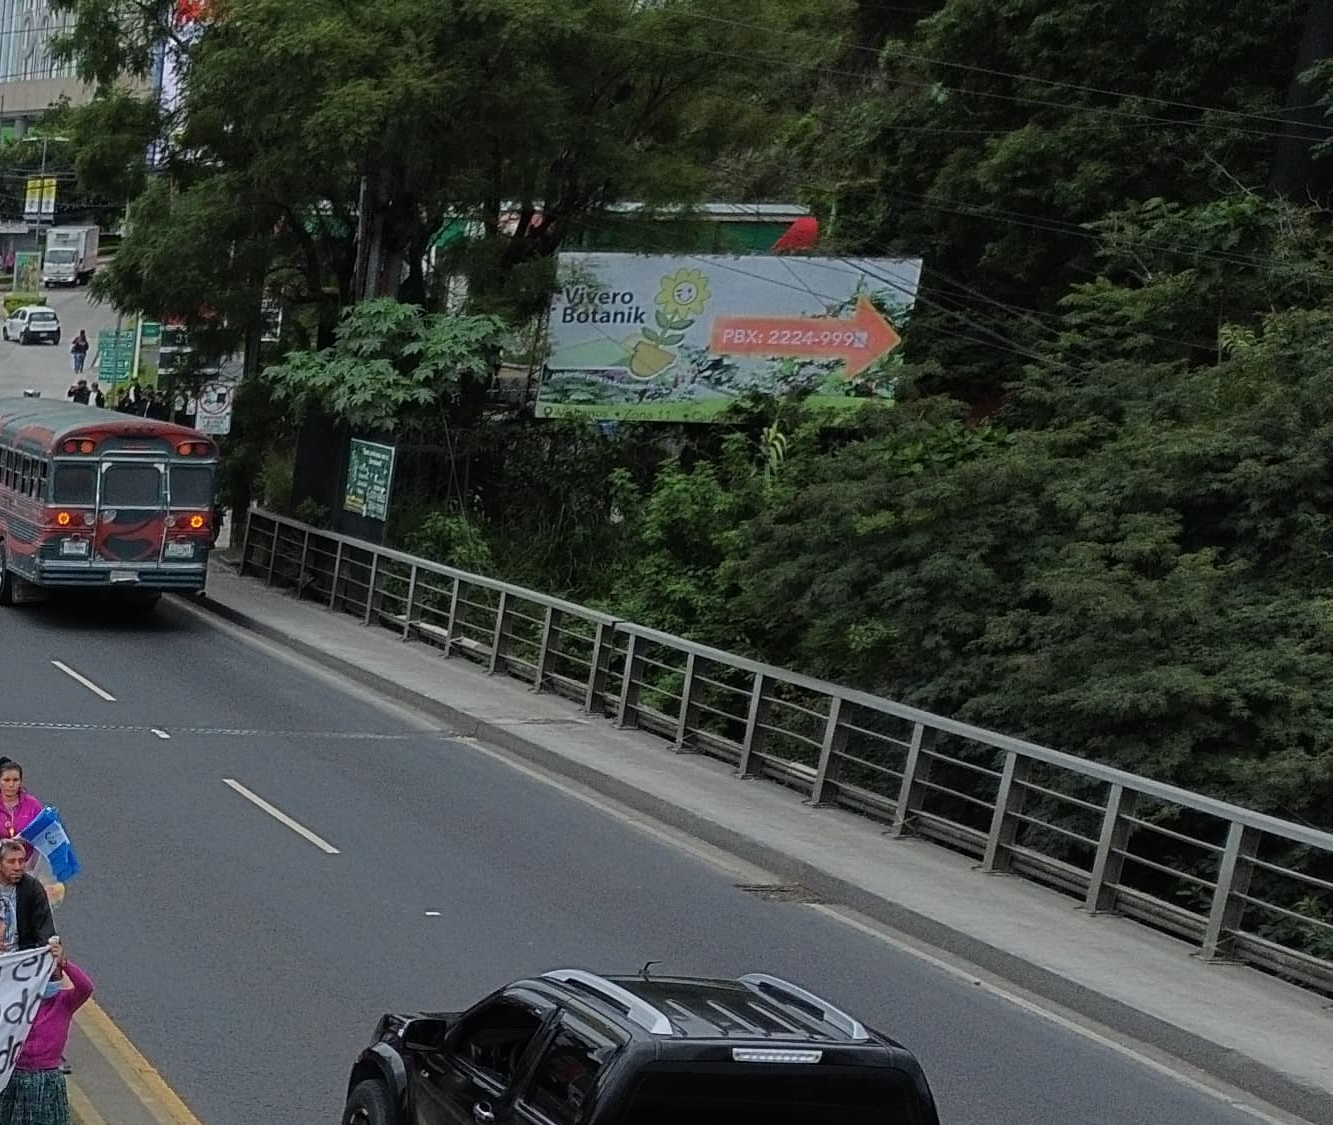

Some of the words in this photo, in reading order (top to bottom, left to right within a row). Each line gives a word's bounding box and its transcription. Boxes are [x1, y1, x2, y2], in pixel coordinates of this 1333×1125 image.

[564, 287, 634, 305] Vivero
[562, 307, 647, 324] Botanik
[723, 330, 763, 345] PBX:
